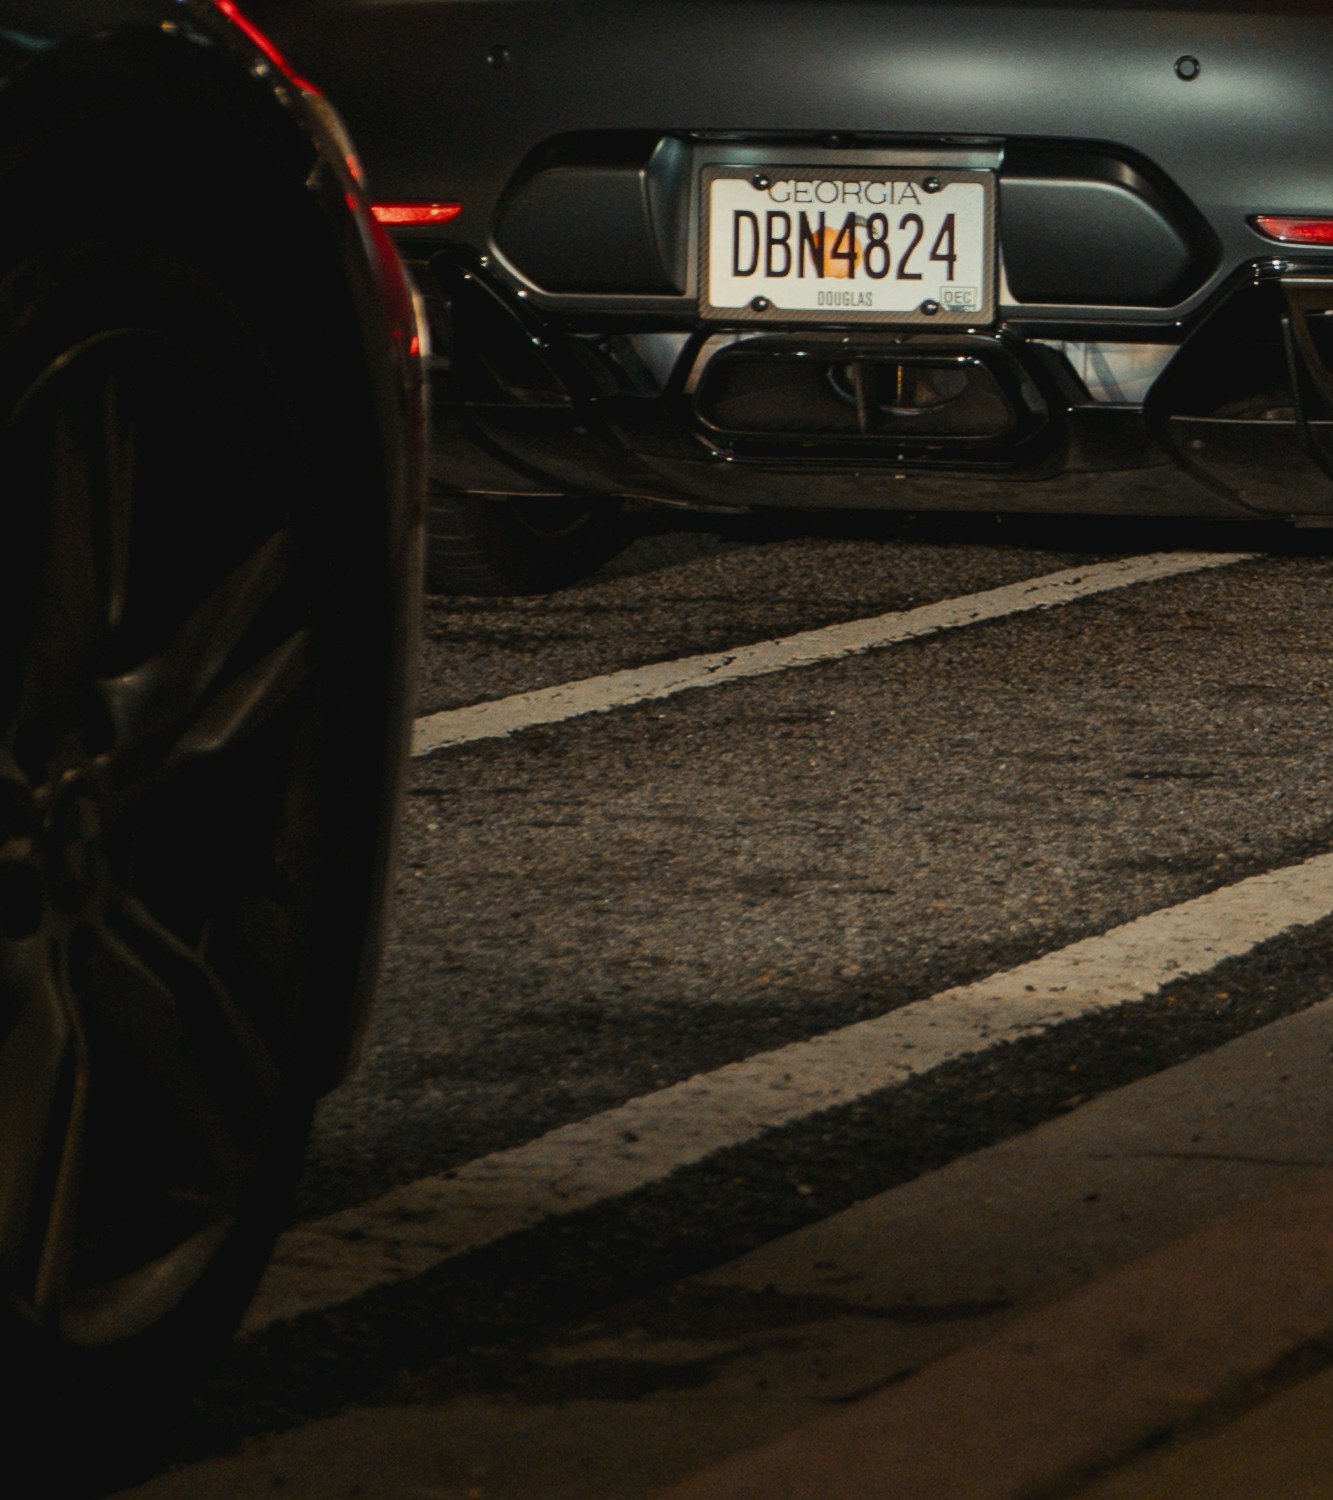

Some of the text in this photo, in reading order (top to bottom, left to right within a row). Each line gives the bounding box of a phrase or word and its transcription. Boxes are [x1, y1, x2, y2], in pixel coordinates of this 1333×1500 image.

[768, 180, 921, 205] GEORGIA
[732, 209, 957, 281] DBN4824
[817, 291, 873, 306] DOUGLAS
[944, 291, 973, 304] DEC
